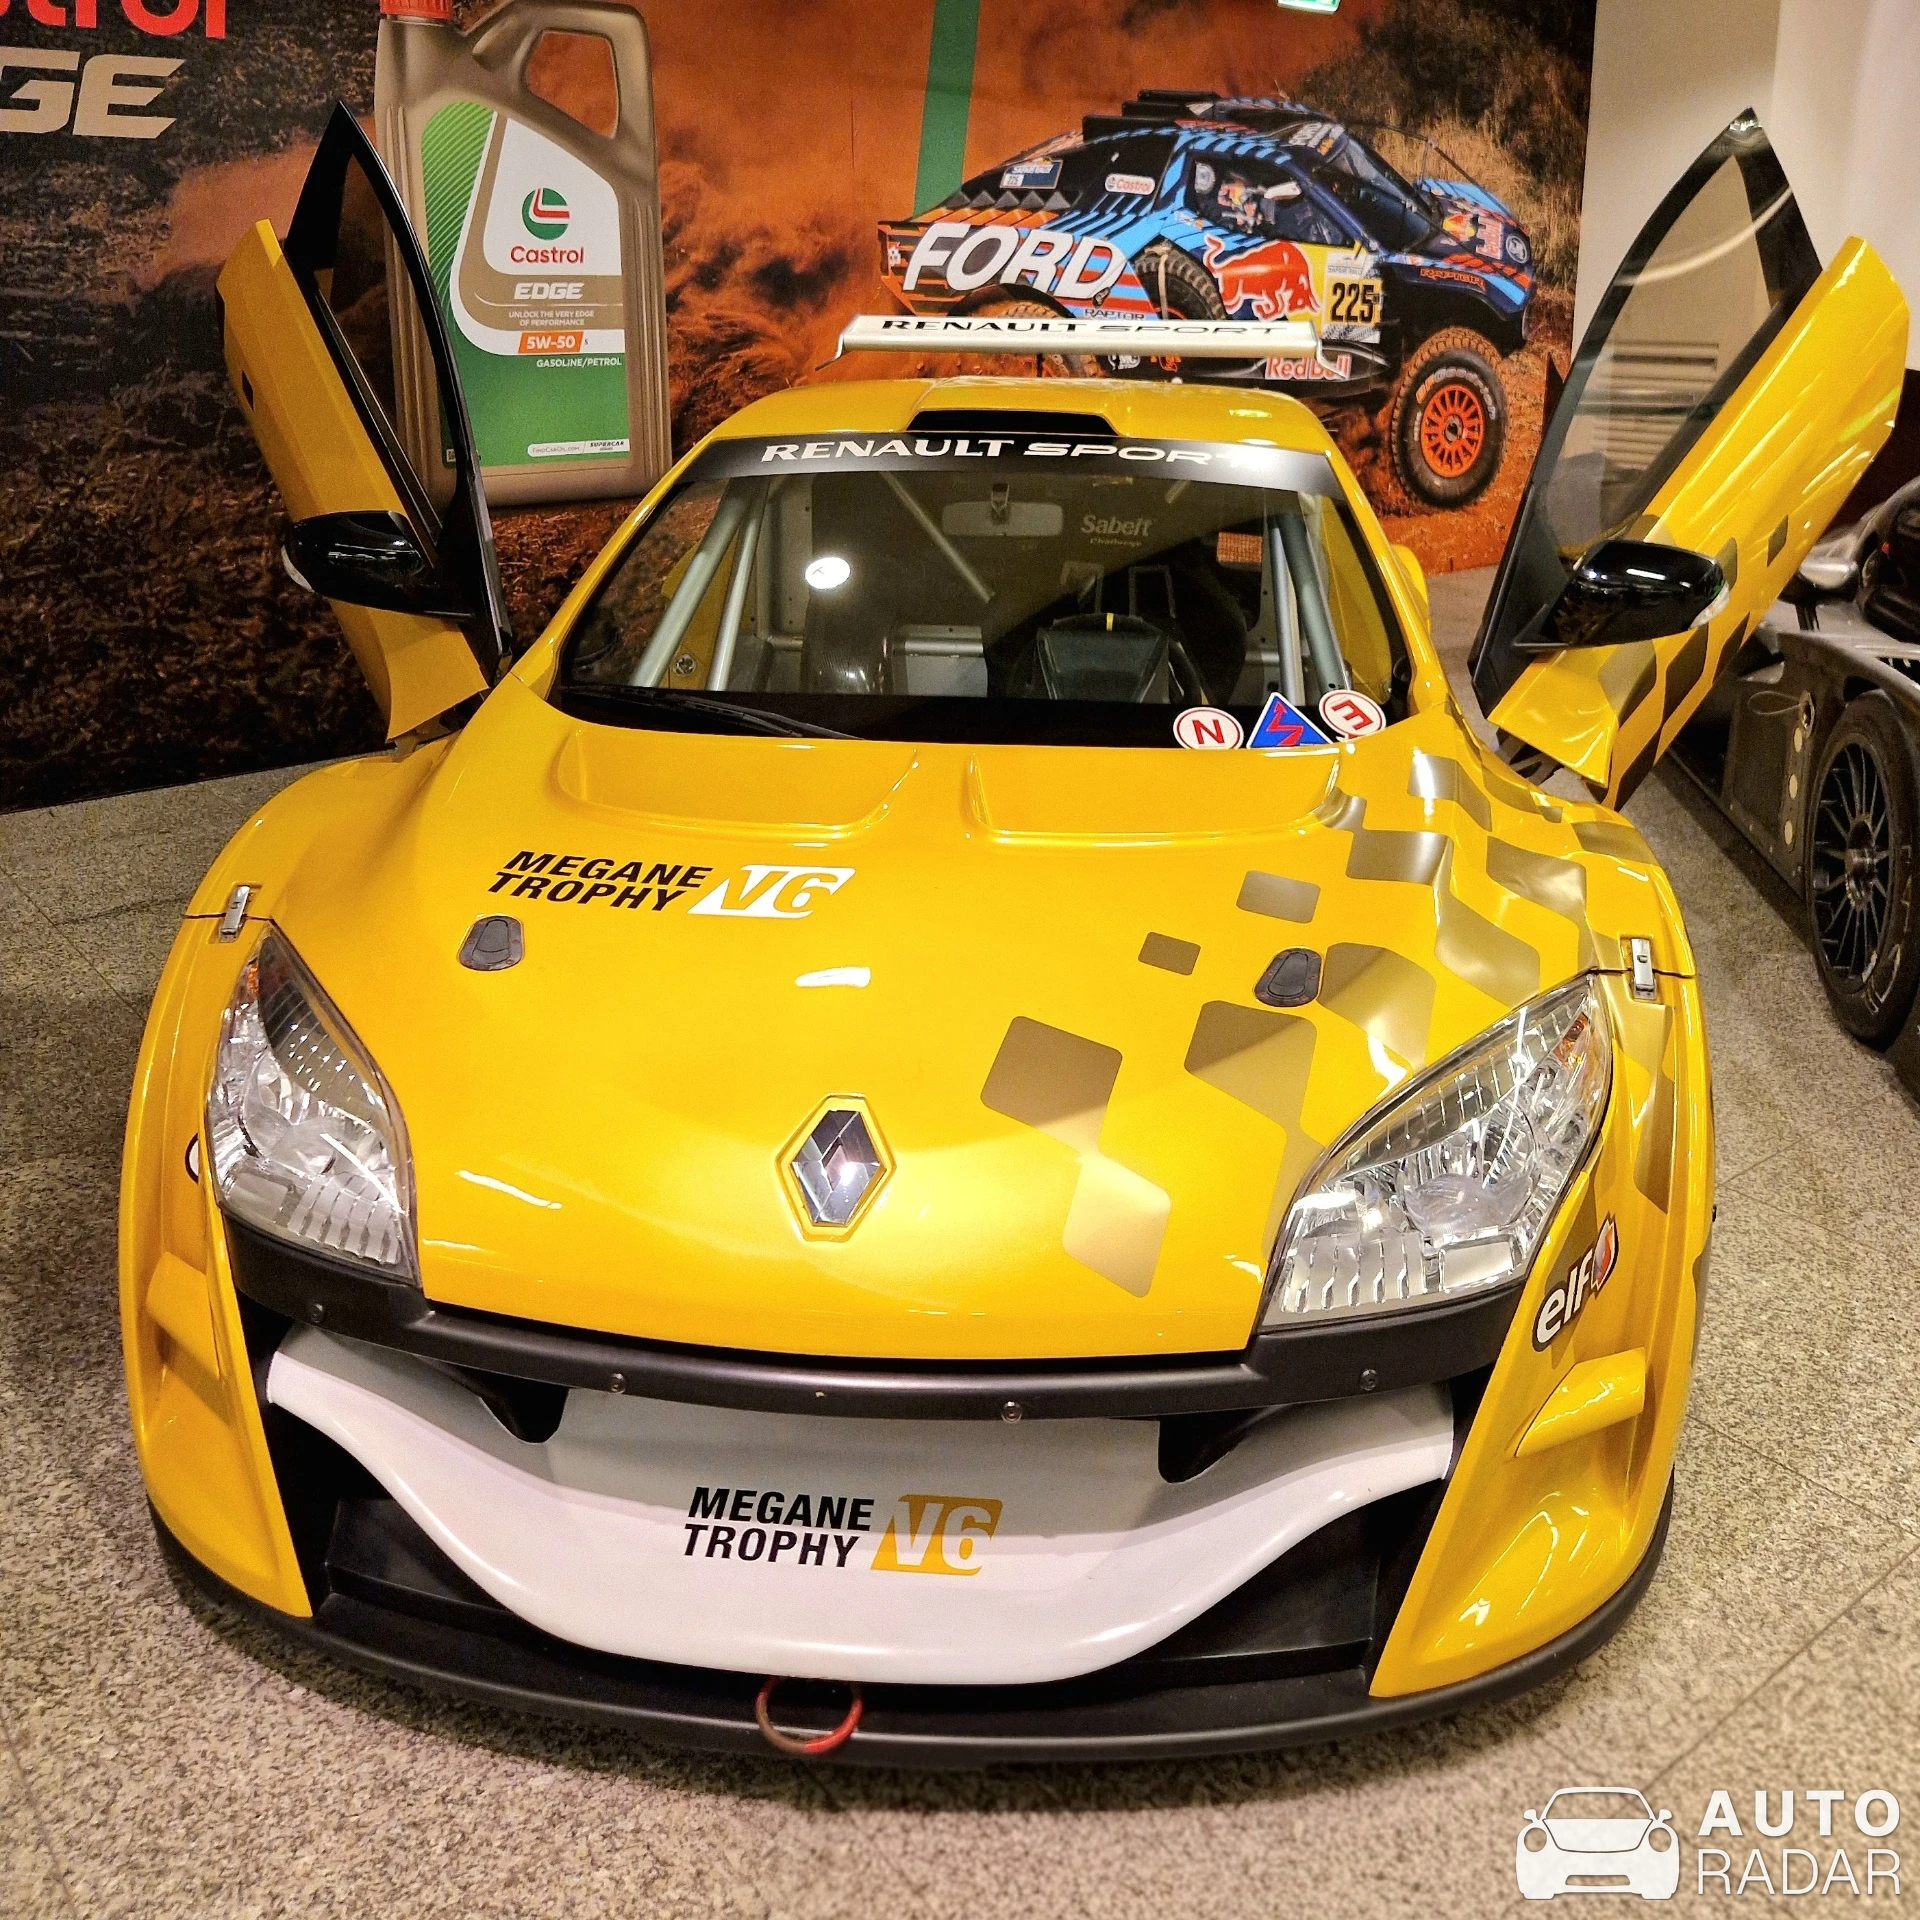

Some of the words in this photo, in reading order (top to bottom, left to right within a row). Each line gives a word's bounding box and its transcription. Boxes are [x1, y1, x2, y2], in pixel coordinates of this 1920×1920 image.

[510, 245, 584, 264] Castrol
[902, 222, 1129, 300] FORD
[513, 282, 585, 300] EDGE
[1330, 282, 1375, 323] 225
[508, 311, 538, 319] UNLOCK
[540, 310, 554, 318] THE
[555, 310, 574, 318] VERY
[575, 310, 595, 318] EDGE
[519, 319, 530, 327] OF
[531, 319, 585, 327] PERFORMANCE
[1083, 308, 1145, 321] RAPTOR
[880, 319, 1087, 333] RENAULT
[1096, 325, 1288, 335] SPORT
[526, 335, 576, 350] 5W-50
[536, 357, 622, 368] GASOLINE/PETROL
[1266, 357, 1308, 379] Red
[589, 440, 625, 448] SUPERCAR
[761, 439, 1015, 462] RENAULT
[1081, 514, 1153, 537] Sabelt
[1192, 718, 1226, 745] N
[487, 871, 690, 912] TROPHY
[503, 850, 713, 889] MEGANE
[700, 866, 848, 917] V6
[1536, 1248, 1594, 1344] elf
[687, 1486, 875, 1531] MEGANE
[880, 1496, 999, 1573] V6
[683, 1523, 860, 1568] TROPHY
